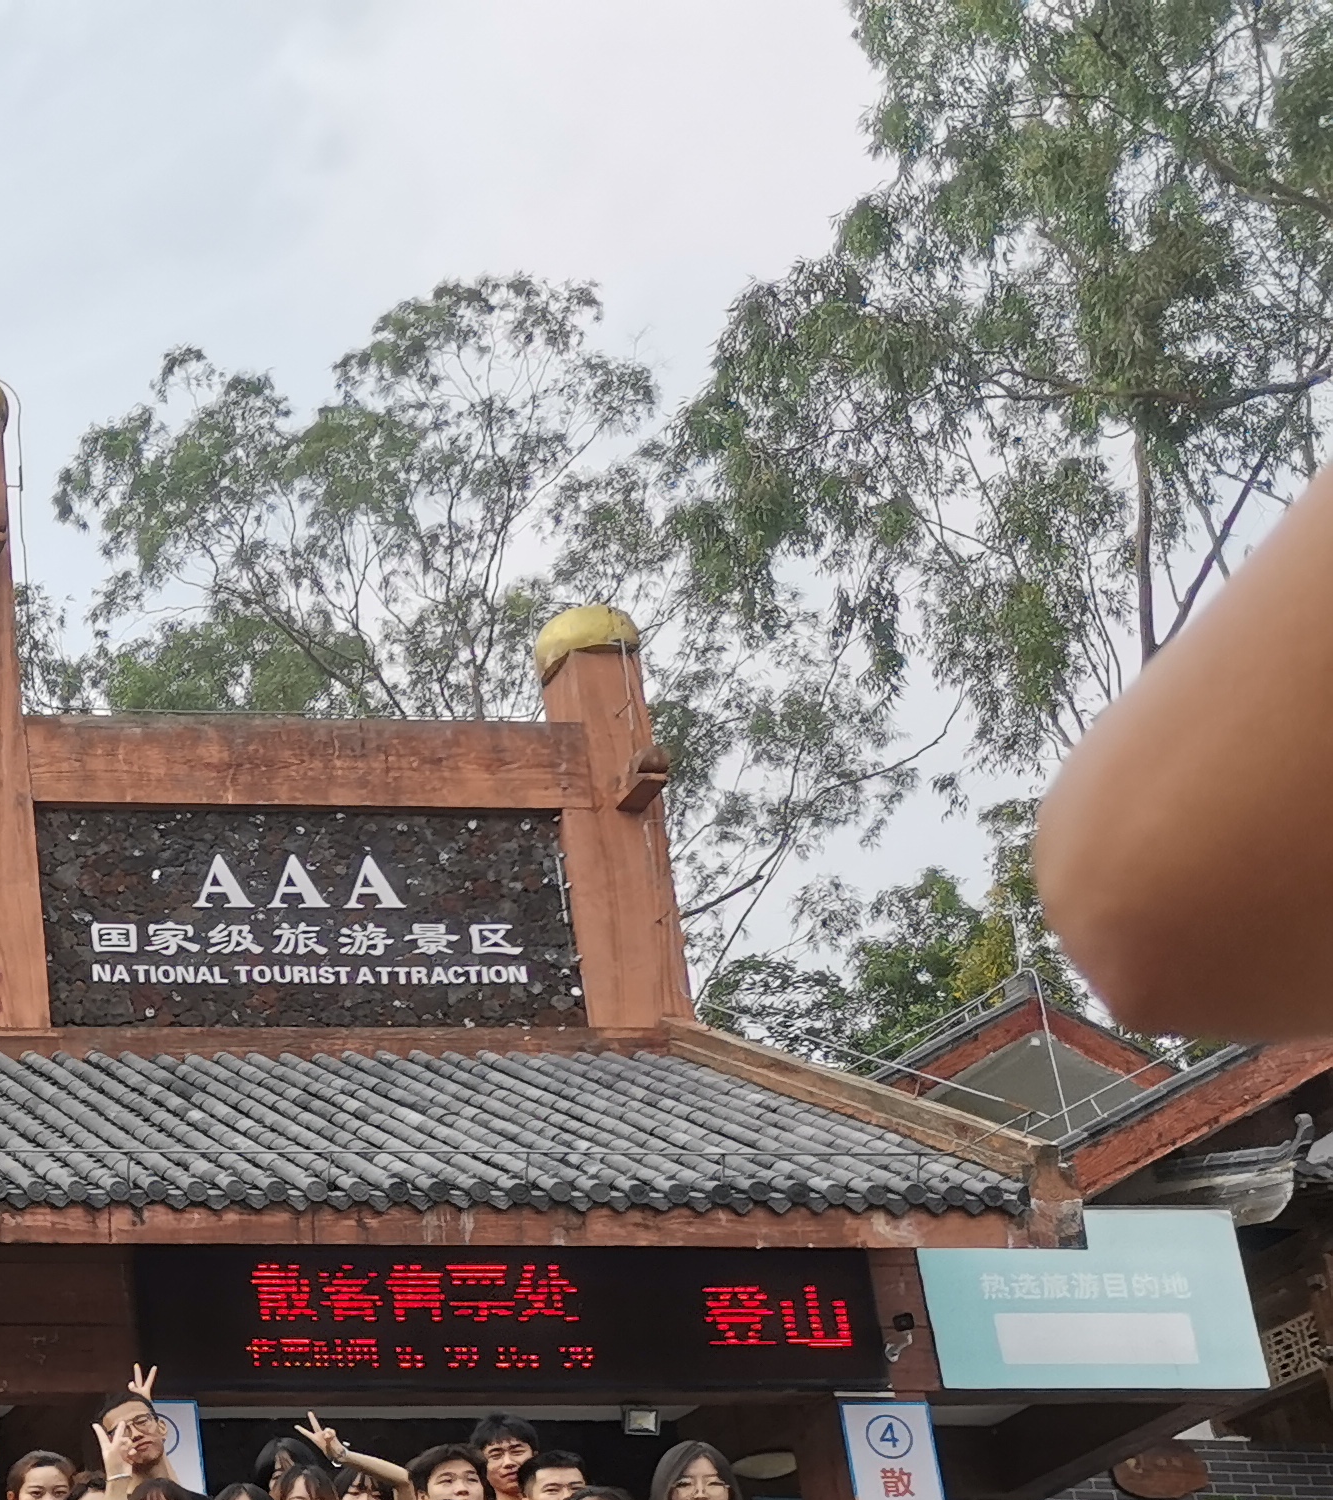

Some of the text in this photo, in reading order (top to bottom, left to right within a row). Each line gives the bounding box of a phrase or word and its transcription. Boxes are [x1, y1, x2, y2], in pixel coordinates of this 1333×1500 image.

[91, 922, 525, 956] 国家级旅游景区
[91, 964, 529, 985] NATIONAL TOURIST ATTRACTION
[980, 1272, 1192, 1300] 热选旅游目的地
[702, 1285, 853, 1348] 登山
